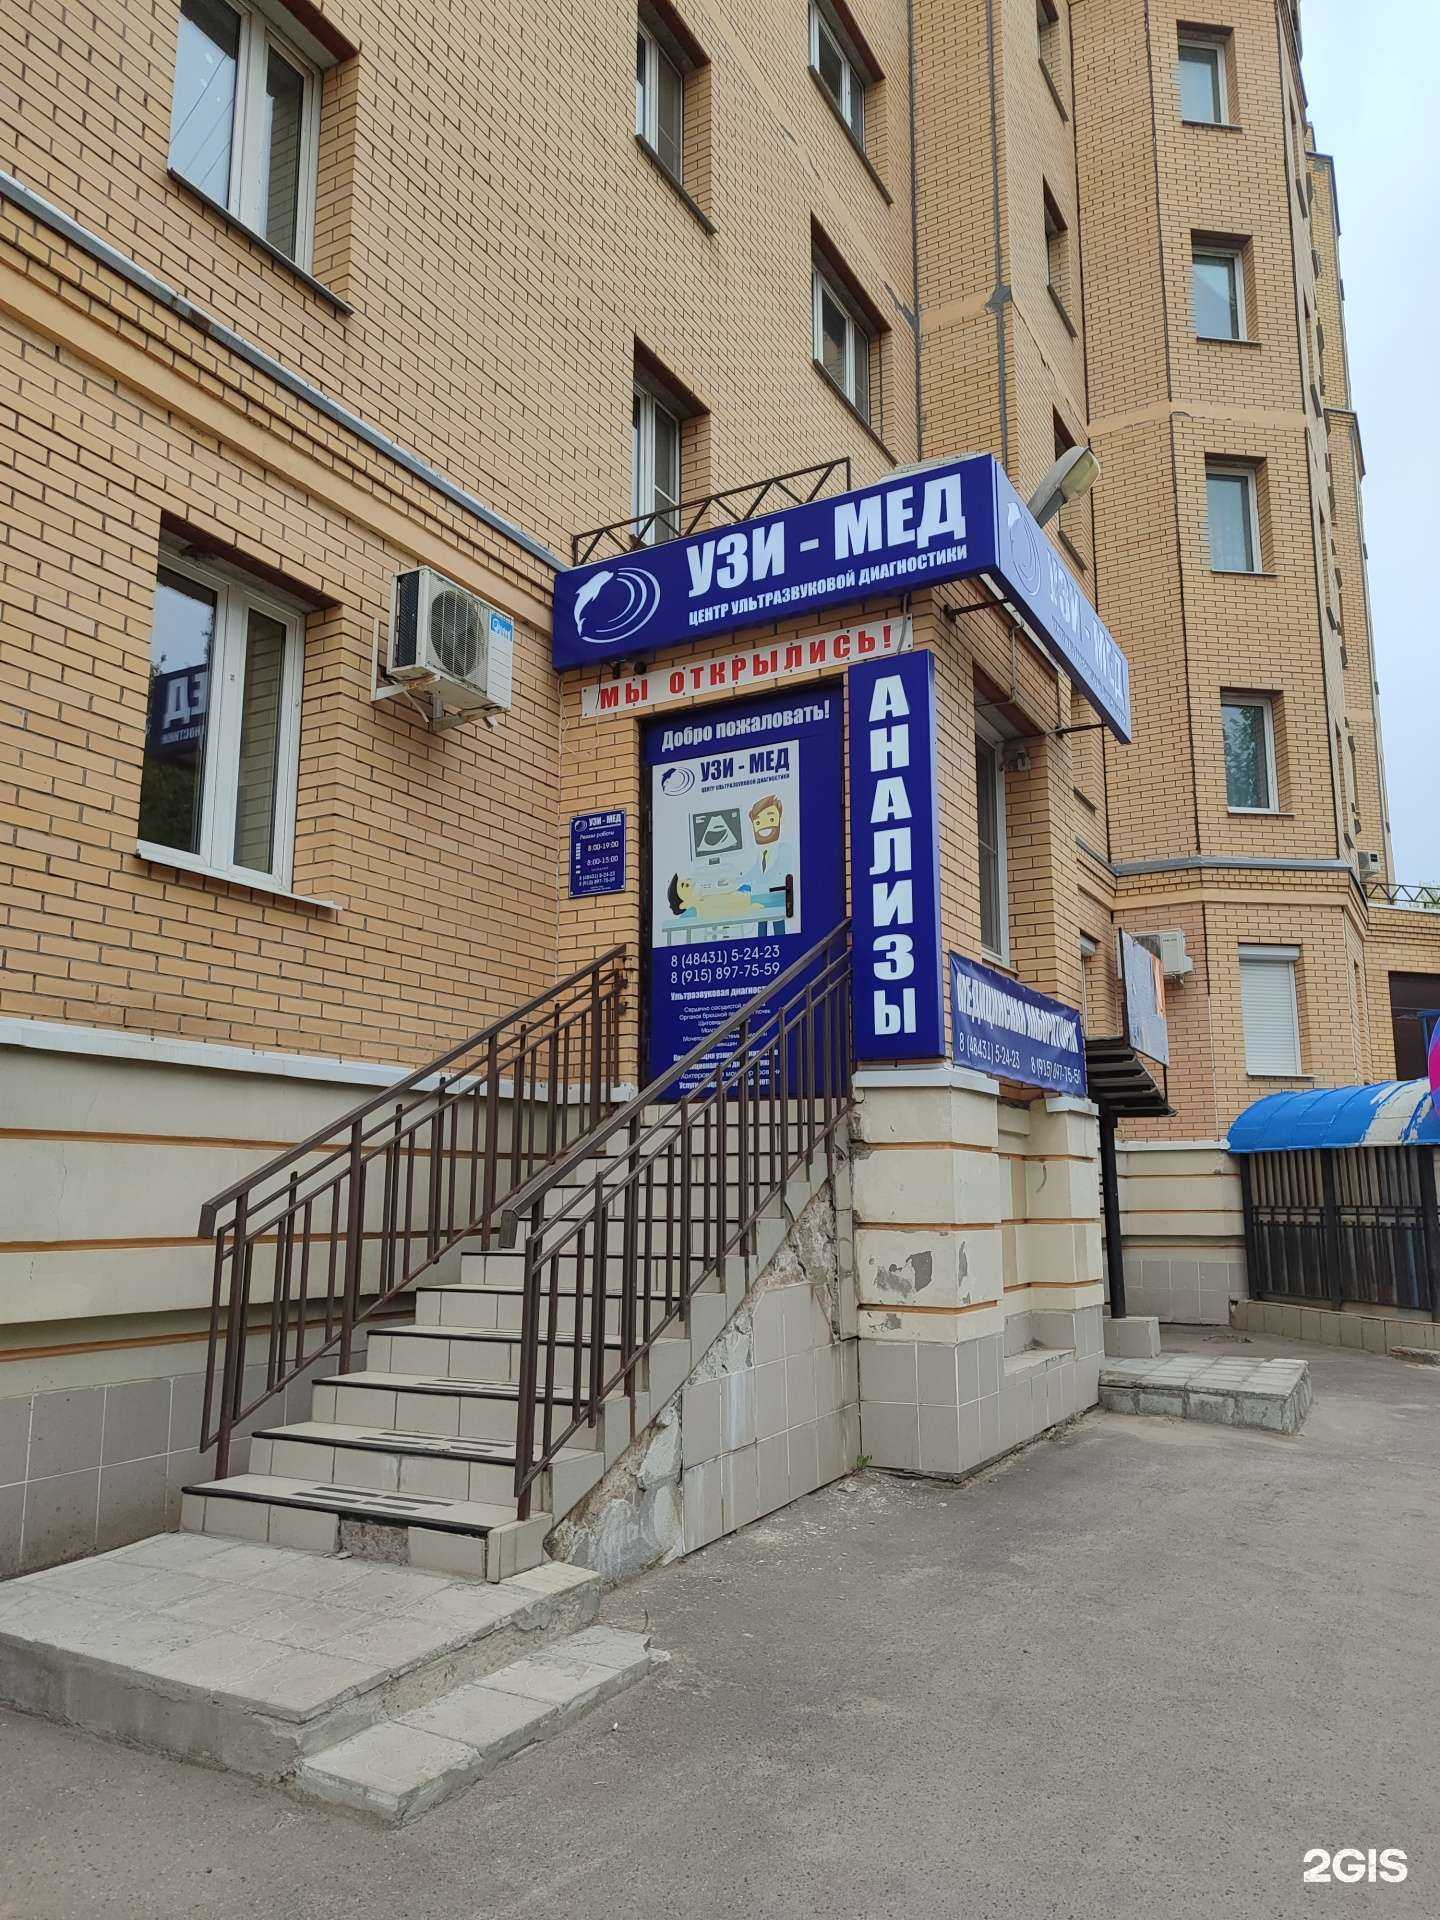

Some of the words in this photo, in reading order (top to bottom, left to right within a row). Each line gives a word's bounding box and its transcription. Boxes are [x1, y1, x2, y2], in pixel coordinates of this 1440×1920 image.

[687, 521, 785, 598] УЗИ
[834, 473, 967, 560] МЕД
[688, 602, 729, 626] ЦЕНТР
[731, 569, 857, 615] УЛЬТРАЗВУКОВОЙ
[858, 544, 967, 587] ДИАГНОСТИКИ
[600, 679, 648, 709] МЫ
[669, 625, 892, 694] ОТКРЫЛИСЬ!
[661, 726, 712, 752] Добро
[715, 700, 830, 739] пожаловать!
[700, 757, 733, 782] УЗИ
[749, 747, 790, 774] МЕД
[868, 674, 917, 1036] АНАЛИЗЫ
[671, 955, 678, 967] 8
[681, 950, 728, 969] (48431)
[731, 944, 780, 962] 5-24-23
[671, 971, 678, 984] 8
[681, 968, 712, 986] (915)
[715, 962, 780, 980] 897-75-59
[959, 1032, 965, 1052] 8
